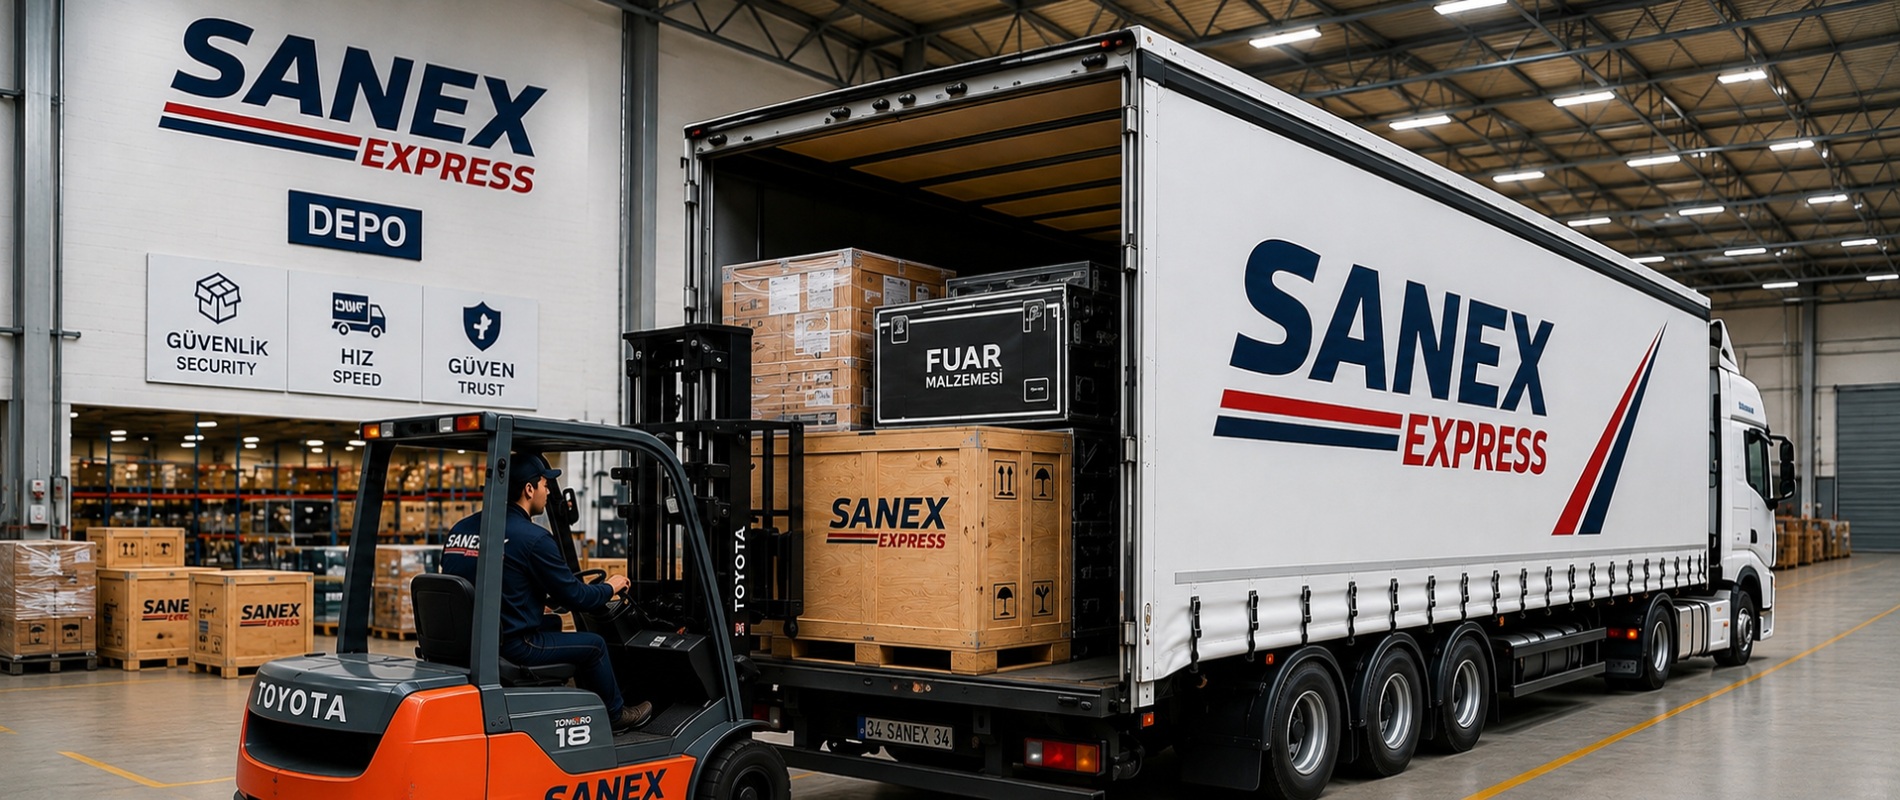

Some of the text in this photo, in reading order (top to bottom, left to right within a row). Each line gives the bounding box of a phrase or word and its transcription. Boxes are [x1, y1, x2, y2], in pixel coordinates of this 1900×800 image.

[171, 17, 548, 157] SANEX
[361, 138, 535, 193] EXPRESS
[308, 203, 407, 247] DEPO
[1230, 239, 1555, 416] SANEX
[166, 330, 269, 356] GÜVENLİK
[176, 356, 257, 376] SECURITY
[341, 348, 374, 367] HIZ
[448, 357, 514, 378] GÜVEN
[926, 343, 1002, 373] FUAR
[333, 370, 382, 387] SPEED
[458, 381, 505, 397] TRUST
[925, 368, 1003, 389] MALZEMESİ
[1402, 413, 1547, 475] EXPRESS
[829, 496, 950, 530] SANEX
[878, 533, 946, 549] EXPRESS
[735, 526, 746, 612] TOYOTA
[143, 599, 189, 614] SANE
[241, 603, 301, 620] SANEX
[257, 681, 346, 722] TOYOTA
[556, 725, 591, 747] 18
[867, 720, 949, 746] 34 SANEX 34
